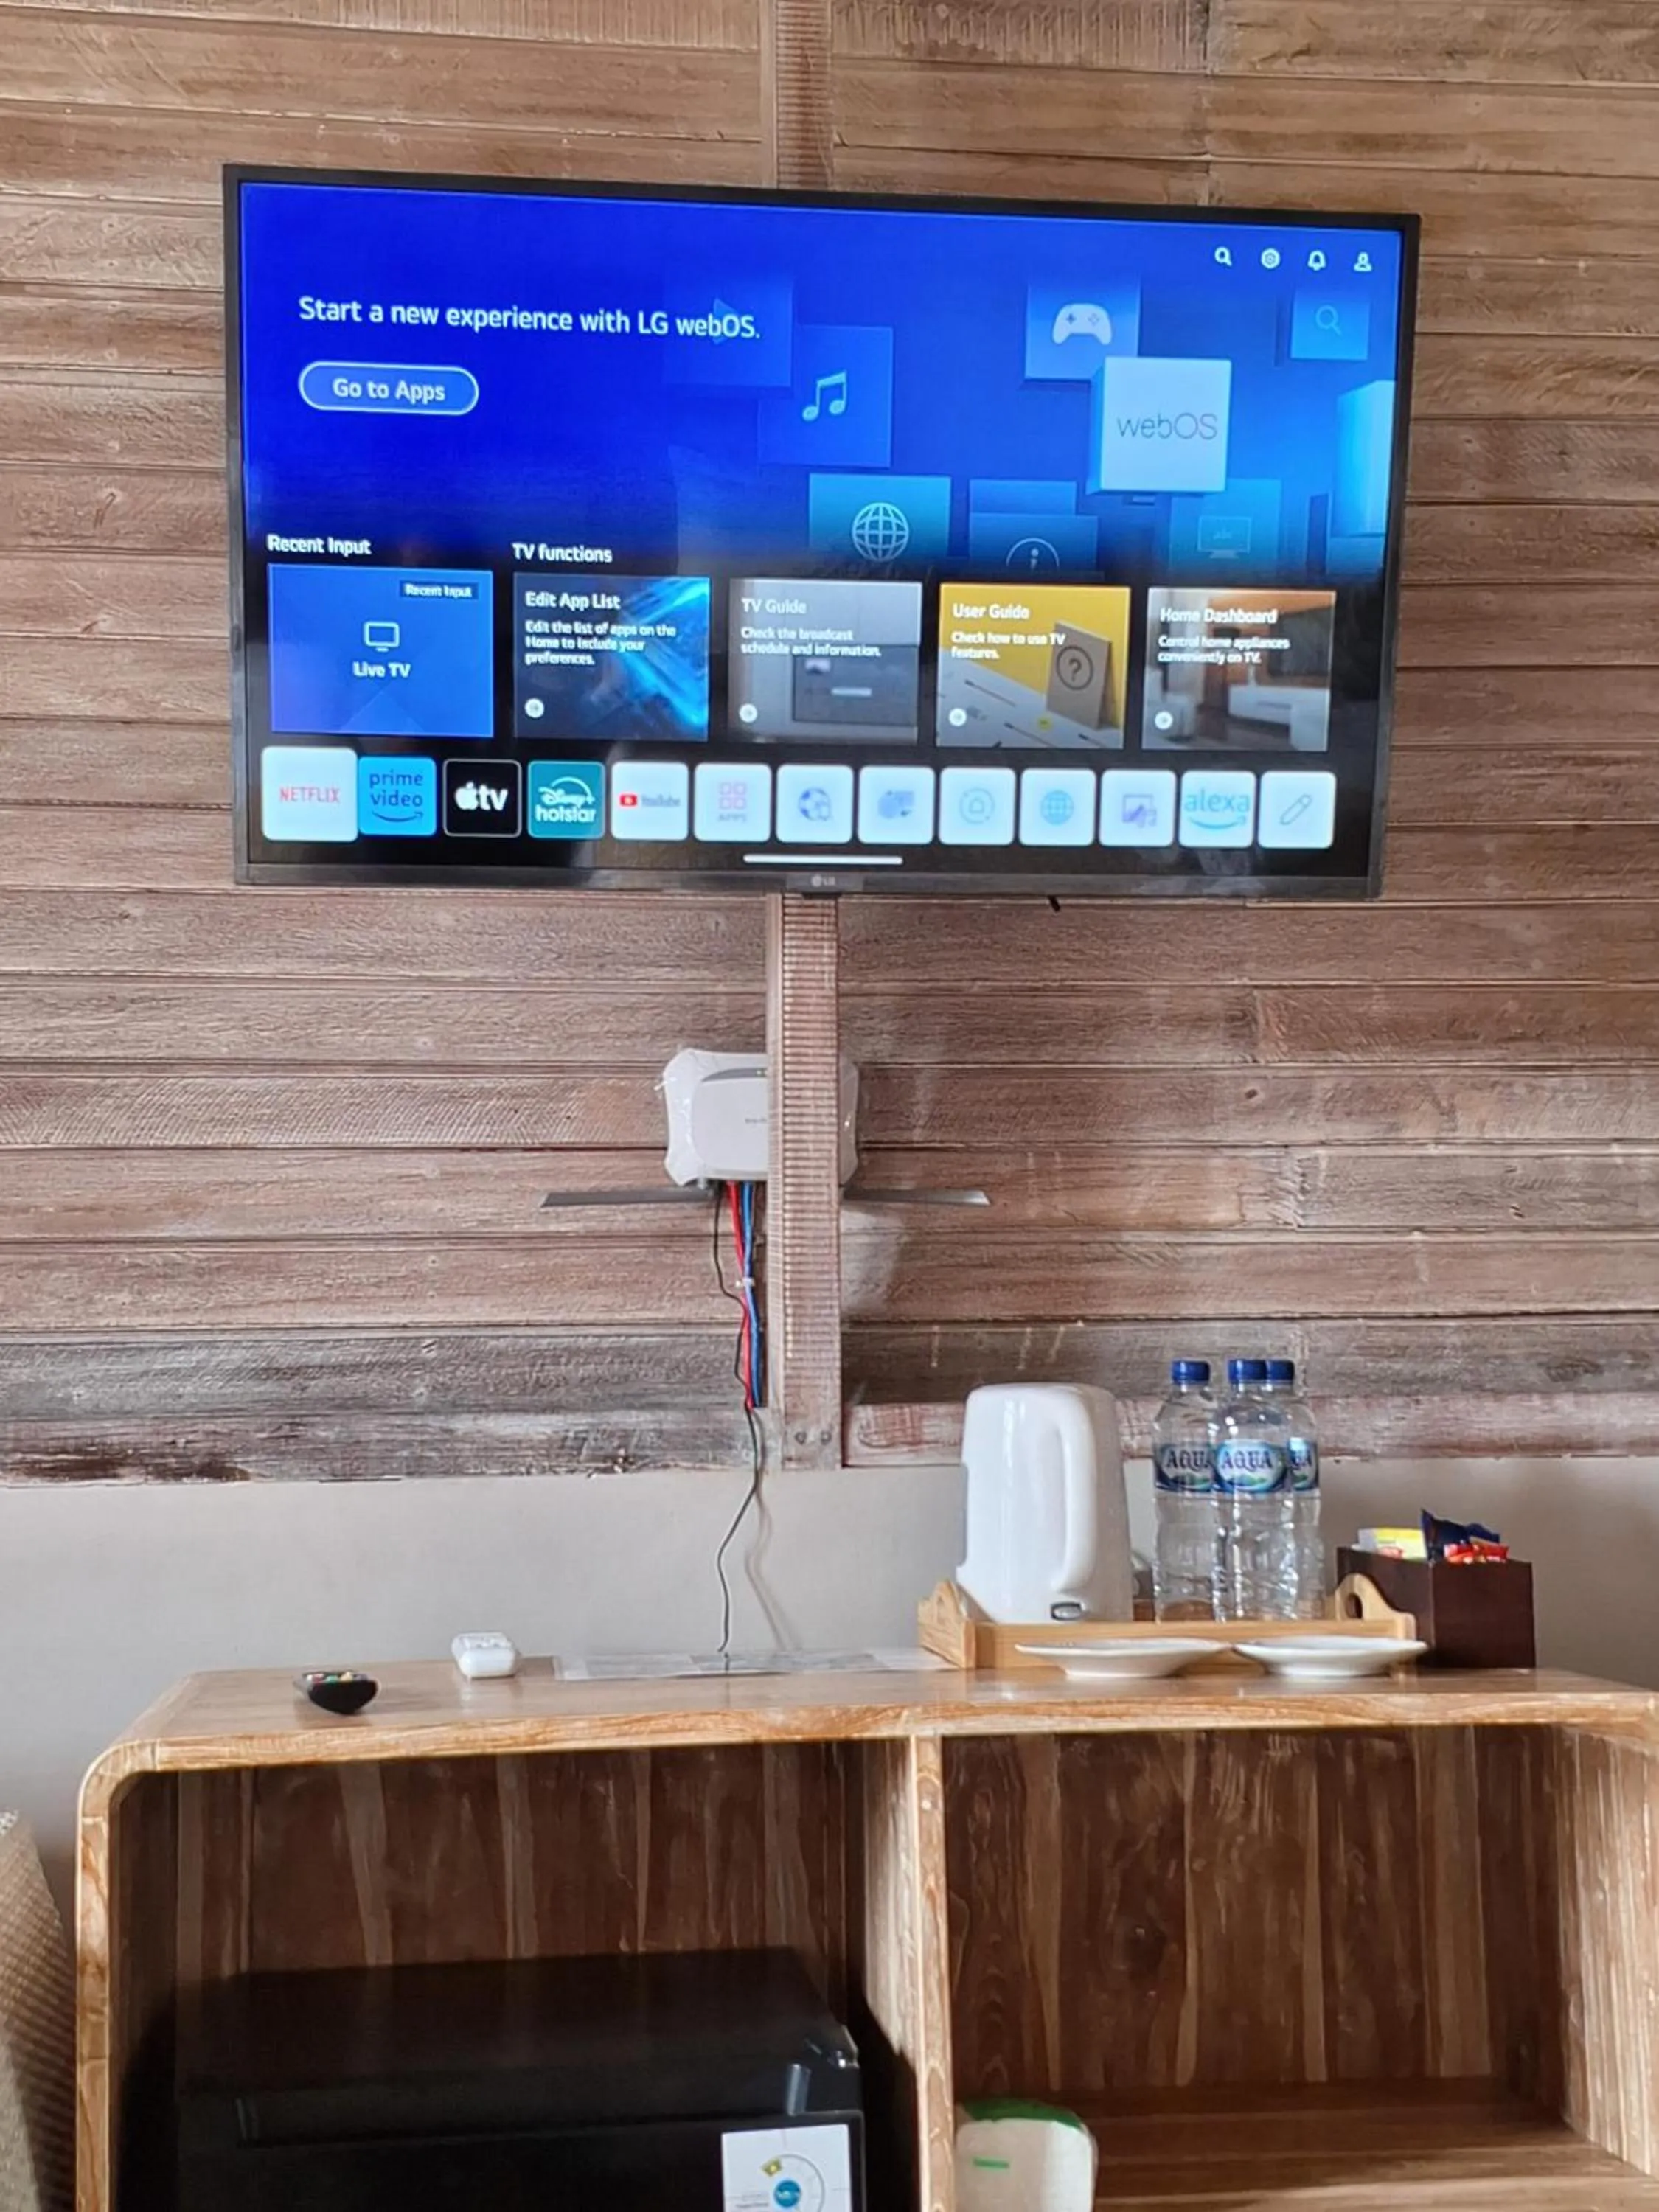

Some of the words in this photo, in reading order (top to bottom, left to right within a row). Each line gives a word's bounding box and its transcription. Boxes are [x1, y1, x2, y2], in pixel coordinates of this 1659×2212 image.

[299, 296, 362, 321] Start
[369, 304, 383, 321] a
[390, 305, 440, 325] new
[445, 307, 574, 333] experience
[580, 309, 630, 333] with
[638, 313, 669, 335] LG
[675, 314, 762, 340] webOS.
[333, 378, 362, 398] Go
[368, 379, 390, 400] to
[394, 380, 446, 404] Apps
[1117, 413, 1218, 440] webOS
[267, 535, 324, 554] Recent
[328, 536, 372, 557] Input
[511, 543, 535, 560] TV
[539, 544, 613, 563] functions
[405, 583, 442, 597] Recent
[444, 585, 472, 599] Input
[525, 592, 556, 607] Edit
[559, 594, 589, 611] App
[593, 595, 621, 609] List
[741, 597, 762, 613] TV
[765, 599, 807, 614] Guide
[953, 603, 986, 618] User
[989, 604, 1030, 619] Guide
[1160, 608, 1201, 622] Home
[1203, 608, 1278, 624] Dashboard
[526, 621, 549, 633] Edit
[552, 622, 572, 634] the
[574, 622, 593, 635] list
[594, 622, 609, 635] of
[610, 626, 638, 637] apps
[656, 625, 677, 637] the
[741, 627, 774, 639] Check
[776, 628, 797, 640] the
[799, 629, 853, 641] broadcast
[526, 636, 560, 649] Home
[561, 637, 575, 649] to
[577, 638, 617, 650] include
[619, 641, 645, 652] your
[951, 631, 985, 644] Check
[987, 632, 1011, 644] how
[1012, 633, 1026, 644] to
[1027, 635, 1048, 645] use
[1049, 633, 1065, 645] TV
[1158, 635, 1199, 648] Control
[1200, 637, 1232, 648] home
[1233, 636, 1291, 650] appliances
[741, 642, 790, 655] schedule
[792, 645, 813, 655] and
[814, 644, 882, 657] information.
[1227, 653, 1242, 663] on
[353, 661, 385, 677] Live
[388, 663, 411, 678] TV
[370, 769, 424, 788] prime
[279, 787, 340, 803] NETFLIX
[370, 789, 423, 807] video
[479, 785, 509, 810] tv
[641, 793, 681, 807] YouTube
[1184, 788, 1250, 812] alexa
[535, 804, 596, 823] hotstar
[1221, 1450, 1273, 1472] AQUA
